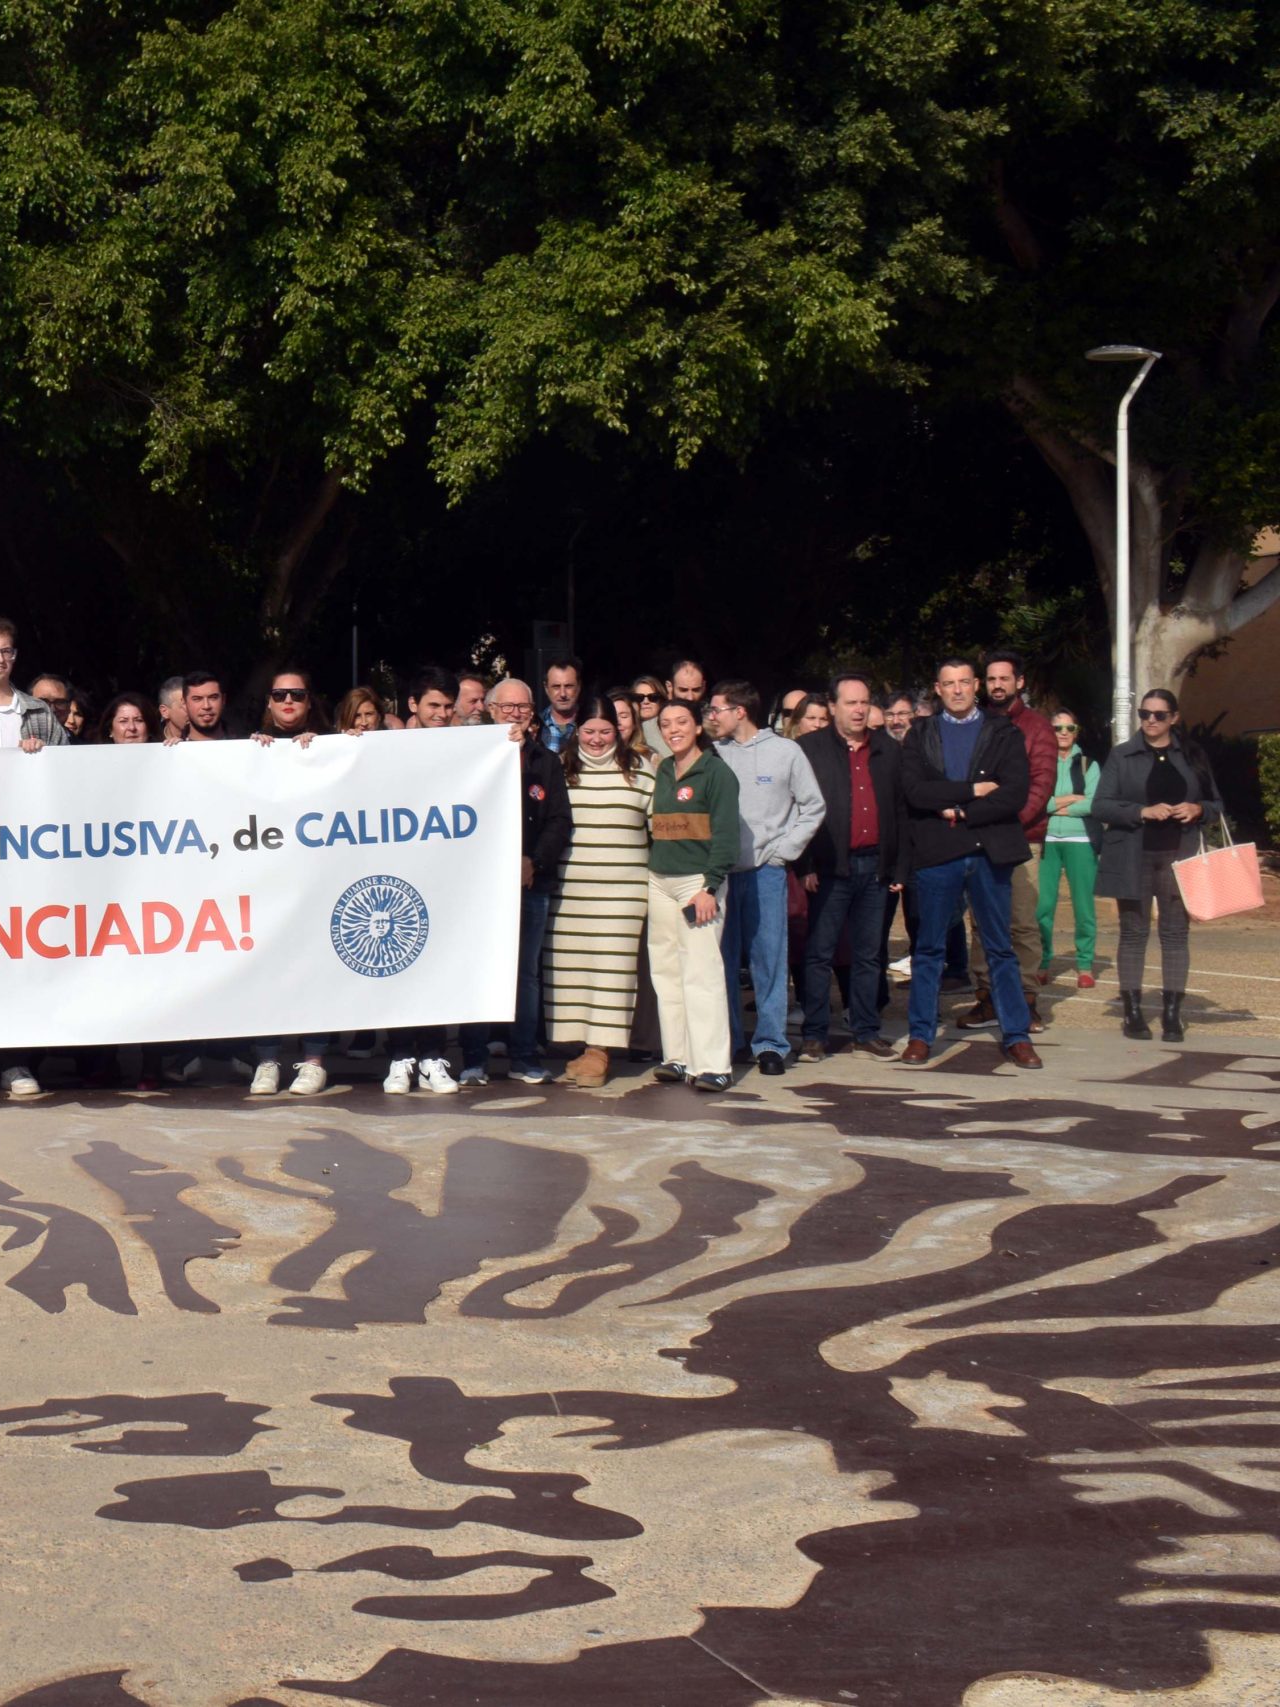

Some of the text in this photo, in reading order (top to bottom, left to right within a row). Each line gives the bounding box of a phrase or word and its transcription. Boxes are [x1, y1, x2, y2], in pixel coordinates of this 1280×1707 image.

[233, 815, 283, 851] de
[296, 804, 477, 847] CALIDAD
[333, 876, 425, 916] IN LUMINE SAPIENTIA
[331, 918, 428, 976] UNIVERSITAS ALMERIENSIS
